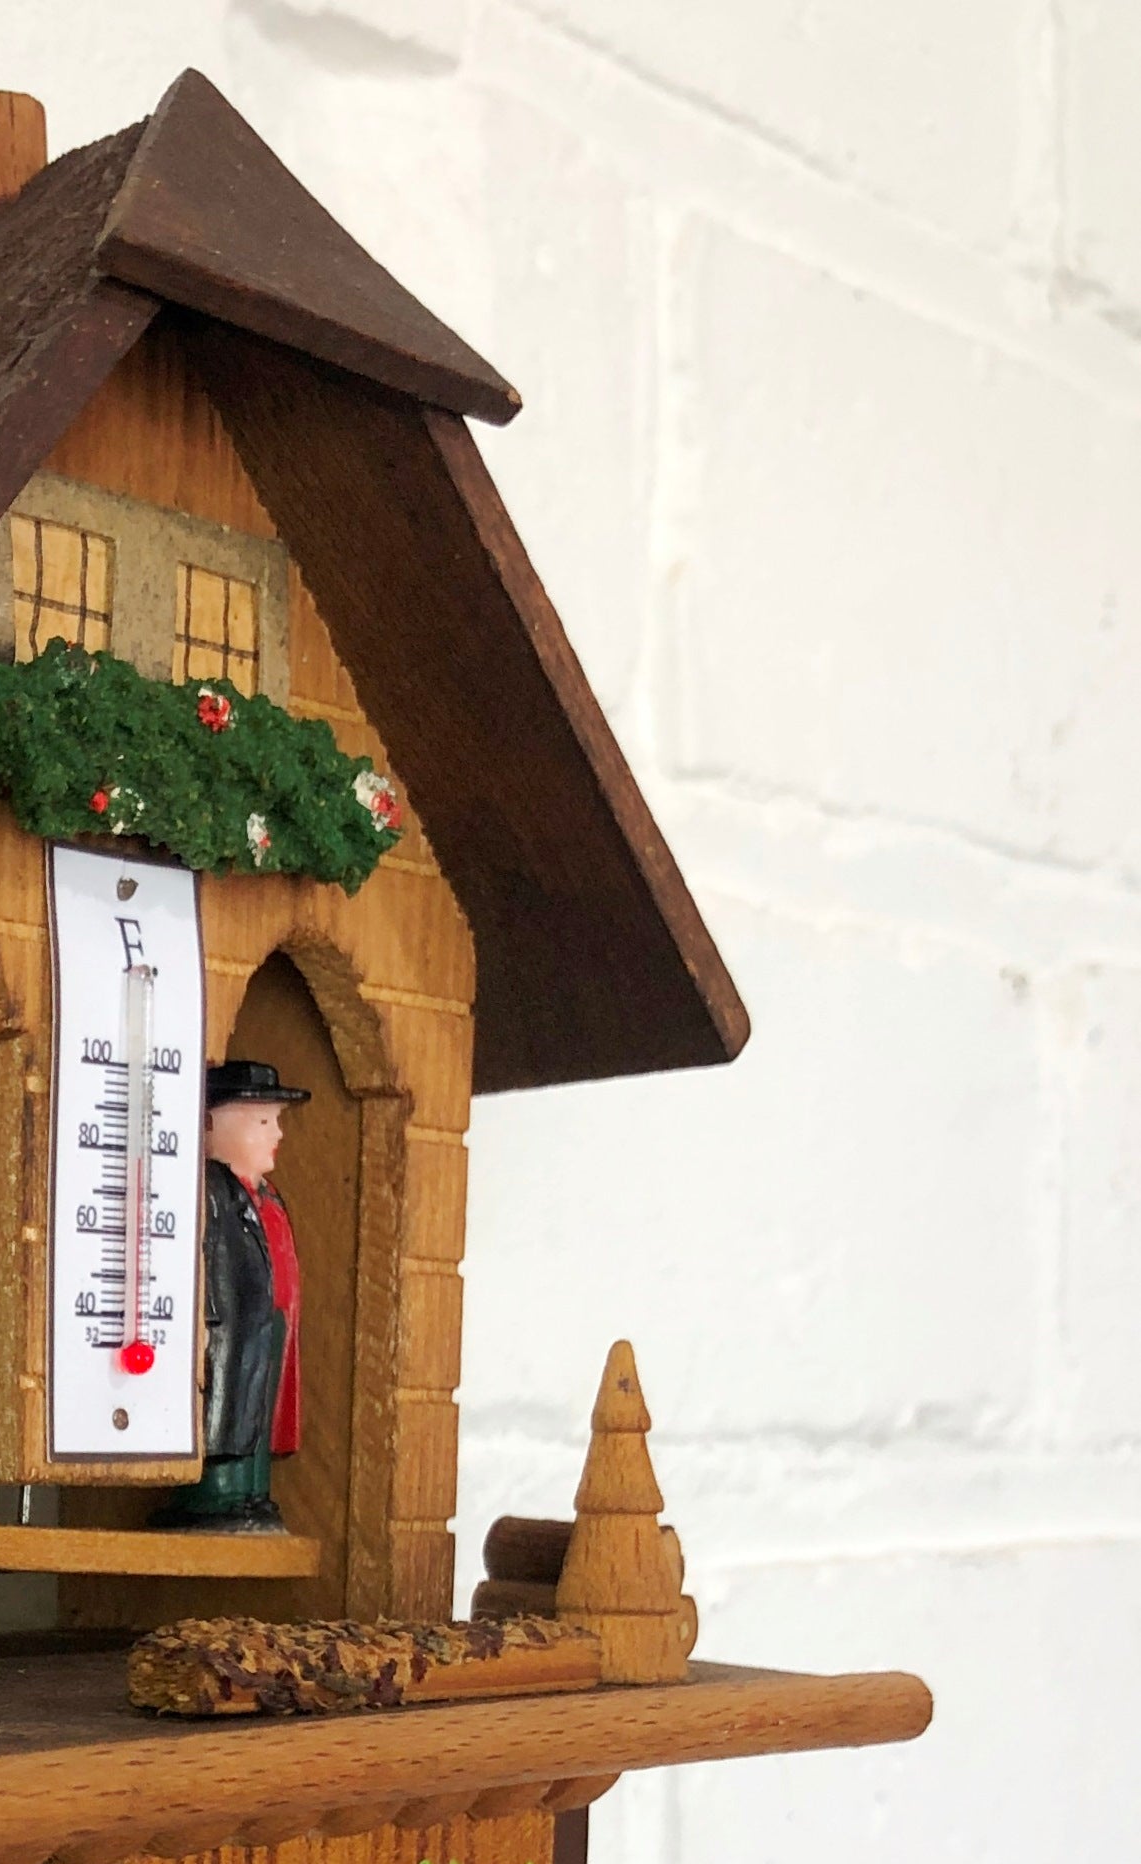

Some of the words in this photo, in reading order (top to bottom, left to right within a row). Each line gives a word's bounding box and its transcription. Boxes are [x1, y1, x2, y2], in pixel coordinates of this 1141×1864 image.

[82, 1037, 112, 1060] 100
[79, 1123, 100, 1146] 80
[157, 1130, 178, 1152] 80
[76, 1205, 98, 1228] 60
[155, 1212, 176, 1234] 60
[75, 1292, 96, 1313] 40
[153, 1295, 174, 1317] 40
[85, 1327, 100, 1343] 32
